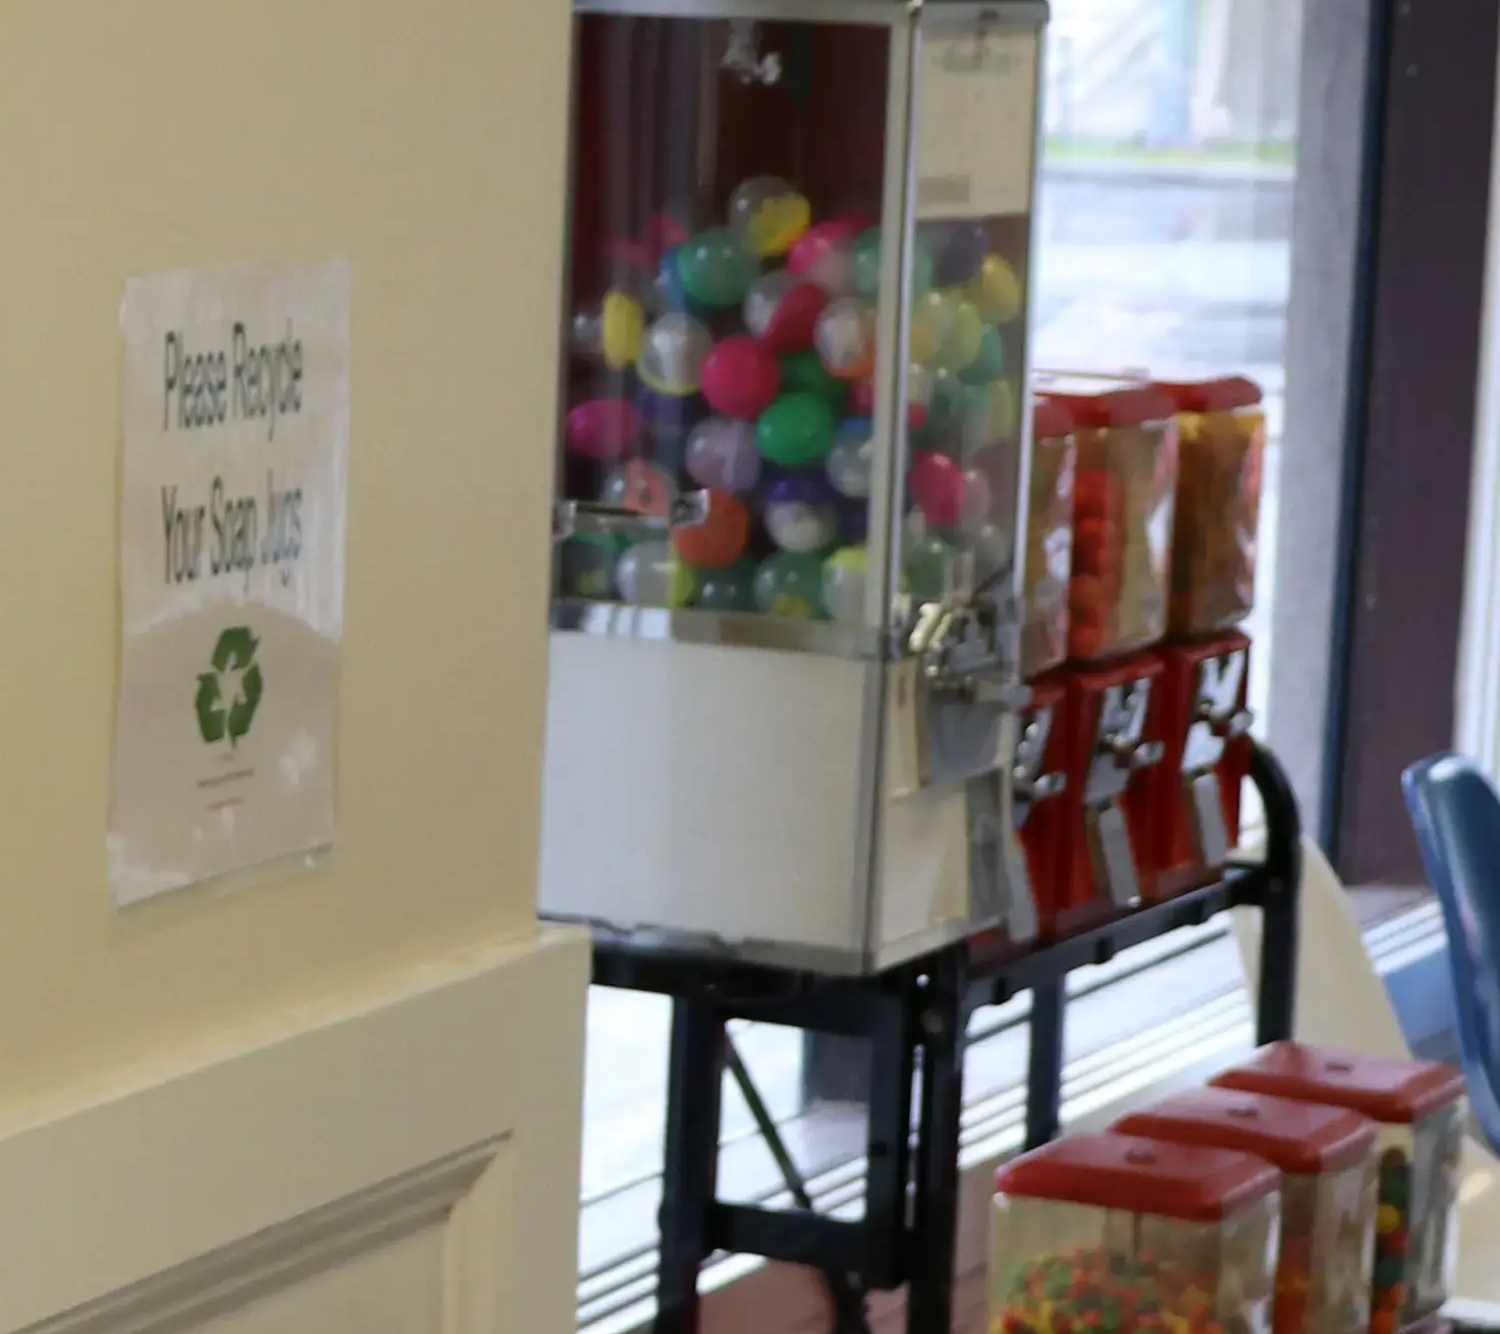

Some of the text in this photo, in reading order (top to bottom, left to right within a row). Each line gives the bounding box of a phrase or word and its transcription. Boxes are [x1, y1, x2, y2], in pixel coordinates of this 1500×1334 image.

[164, 317, 303, 443] Please Recycle
[160, 484, 206, 585] Your
[211, 474, 258, 593] Soap
